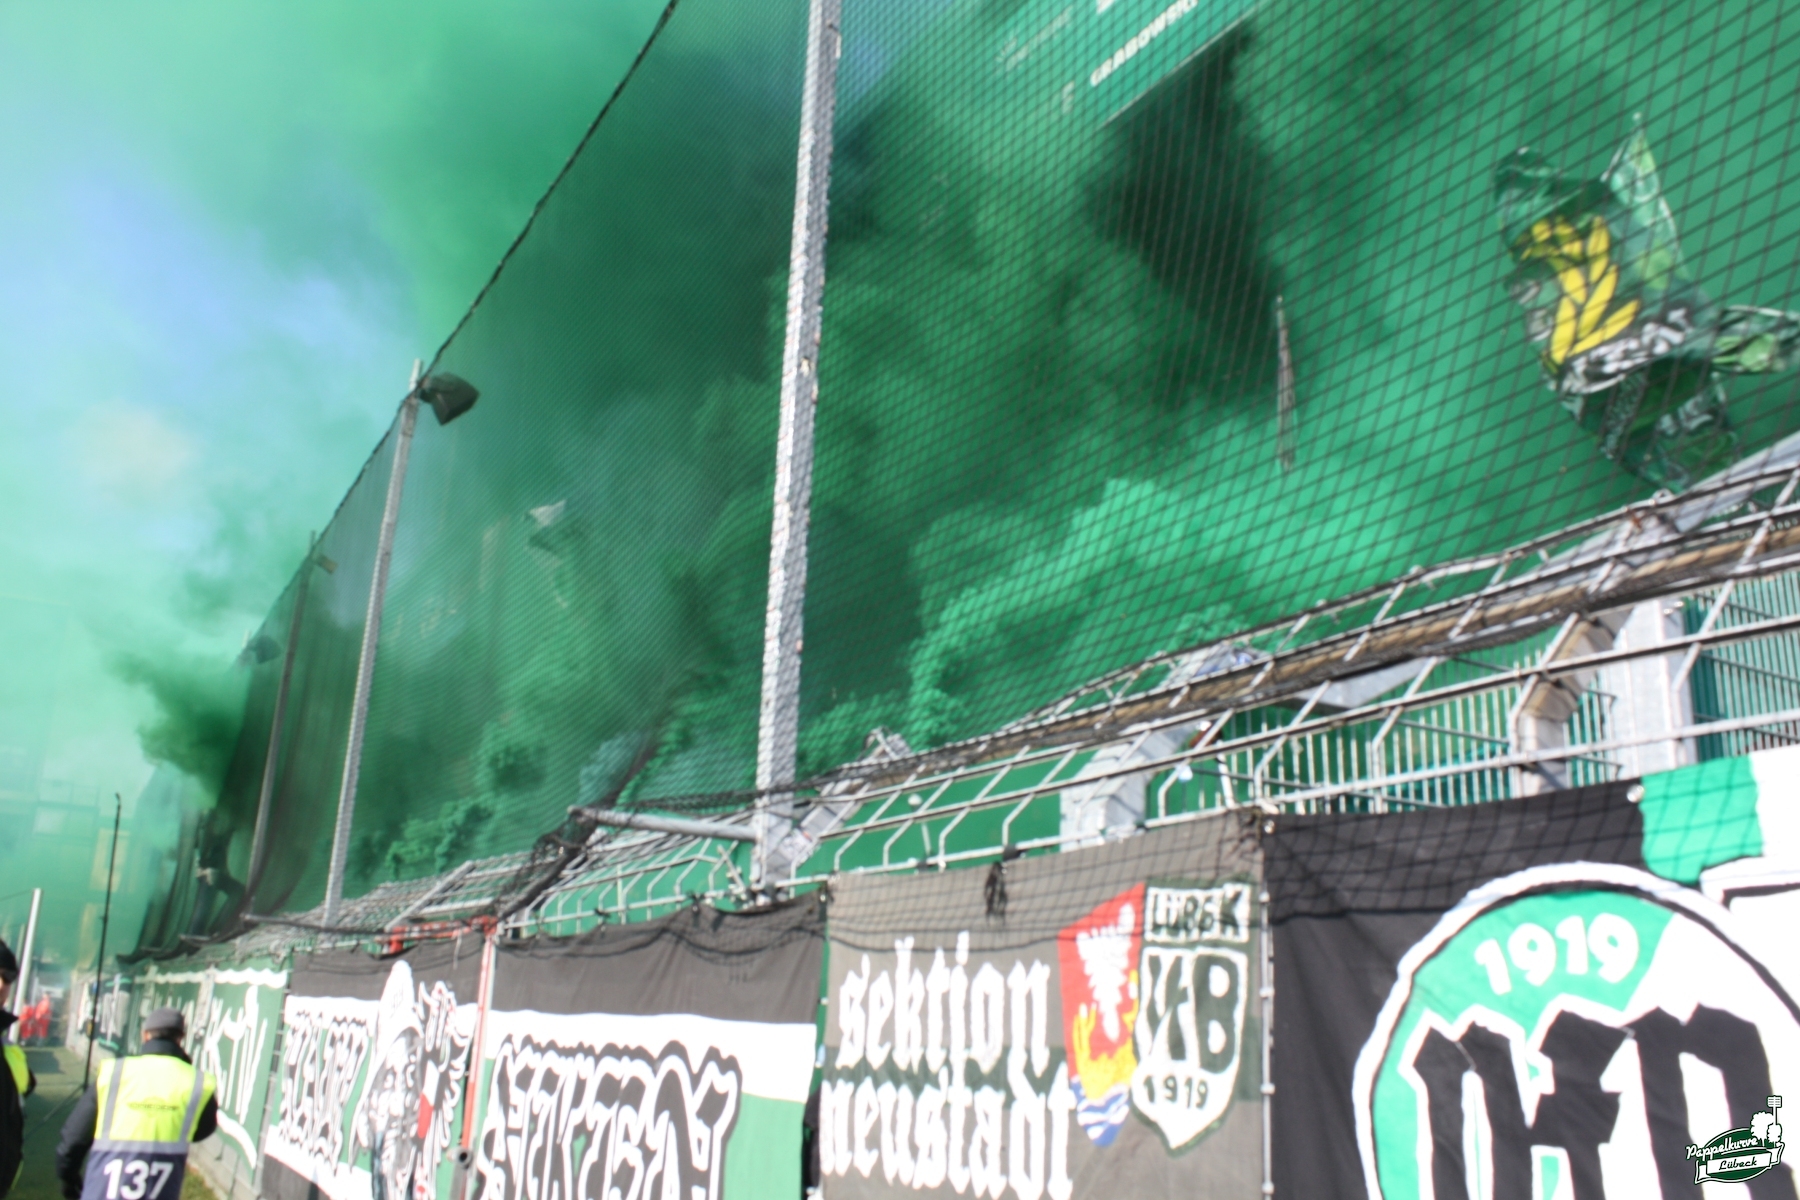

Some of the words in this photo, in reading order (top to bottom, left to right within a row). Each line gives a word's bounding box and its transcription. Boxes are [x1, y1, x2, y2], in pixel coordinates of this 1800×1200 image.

[1474, 912, 1639, 995] 1919
[836, 931, 1051, 1078] sektion
[819, 1062, 1077, 1200] neustadt
[1143, 1075, 1209, 1111] 1919
[103, 1158, 174, 1200] 137
